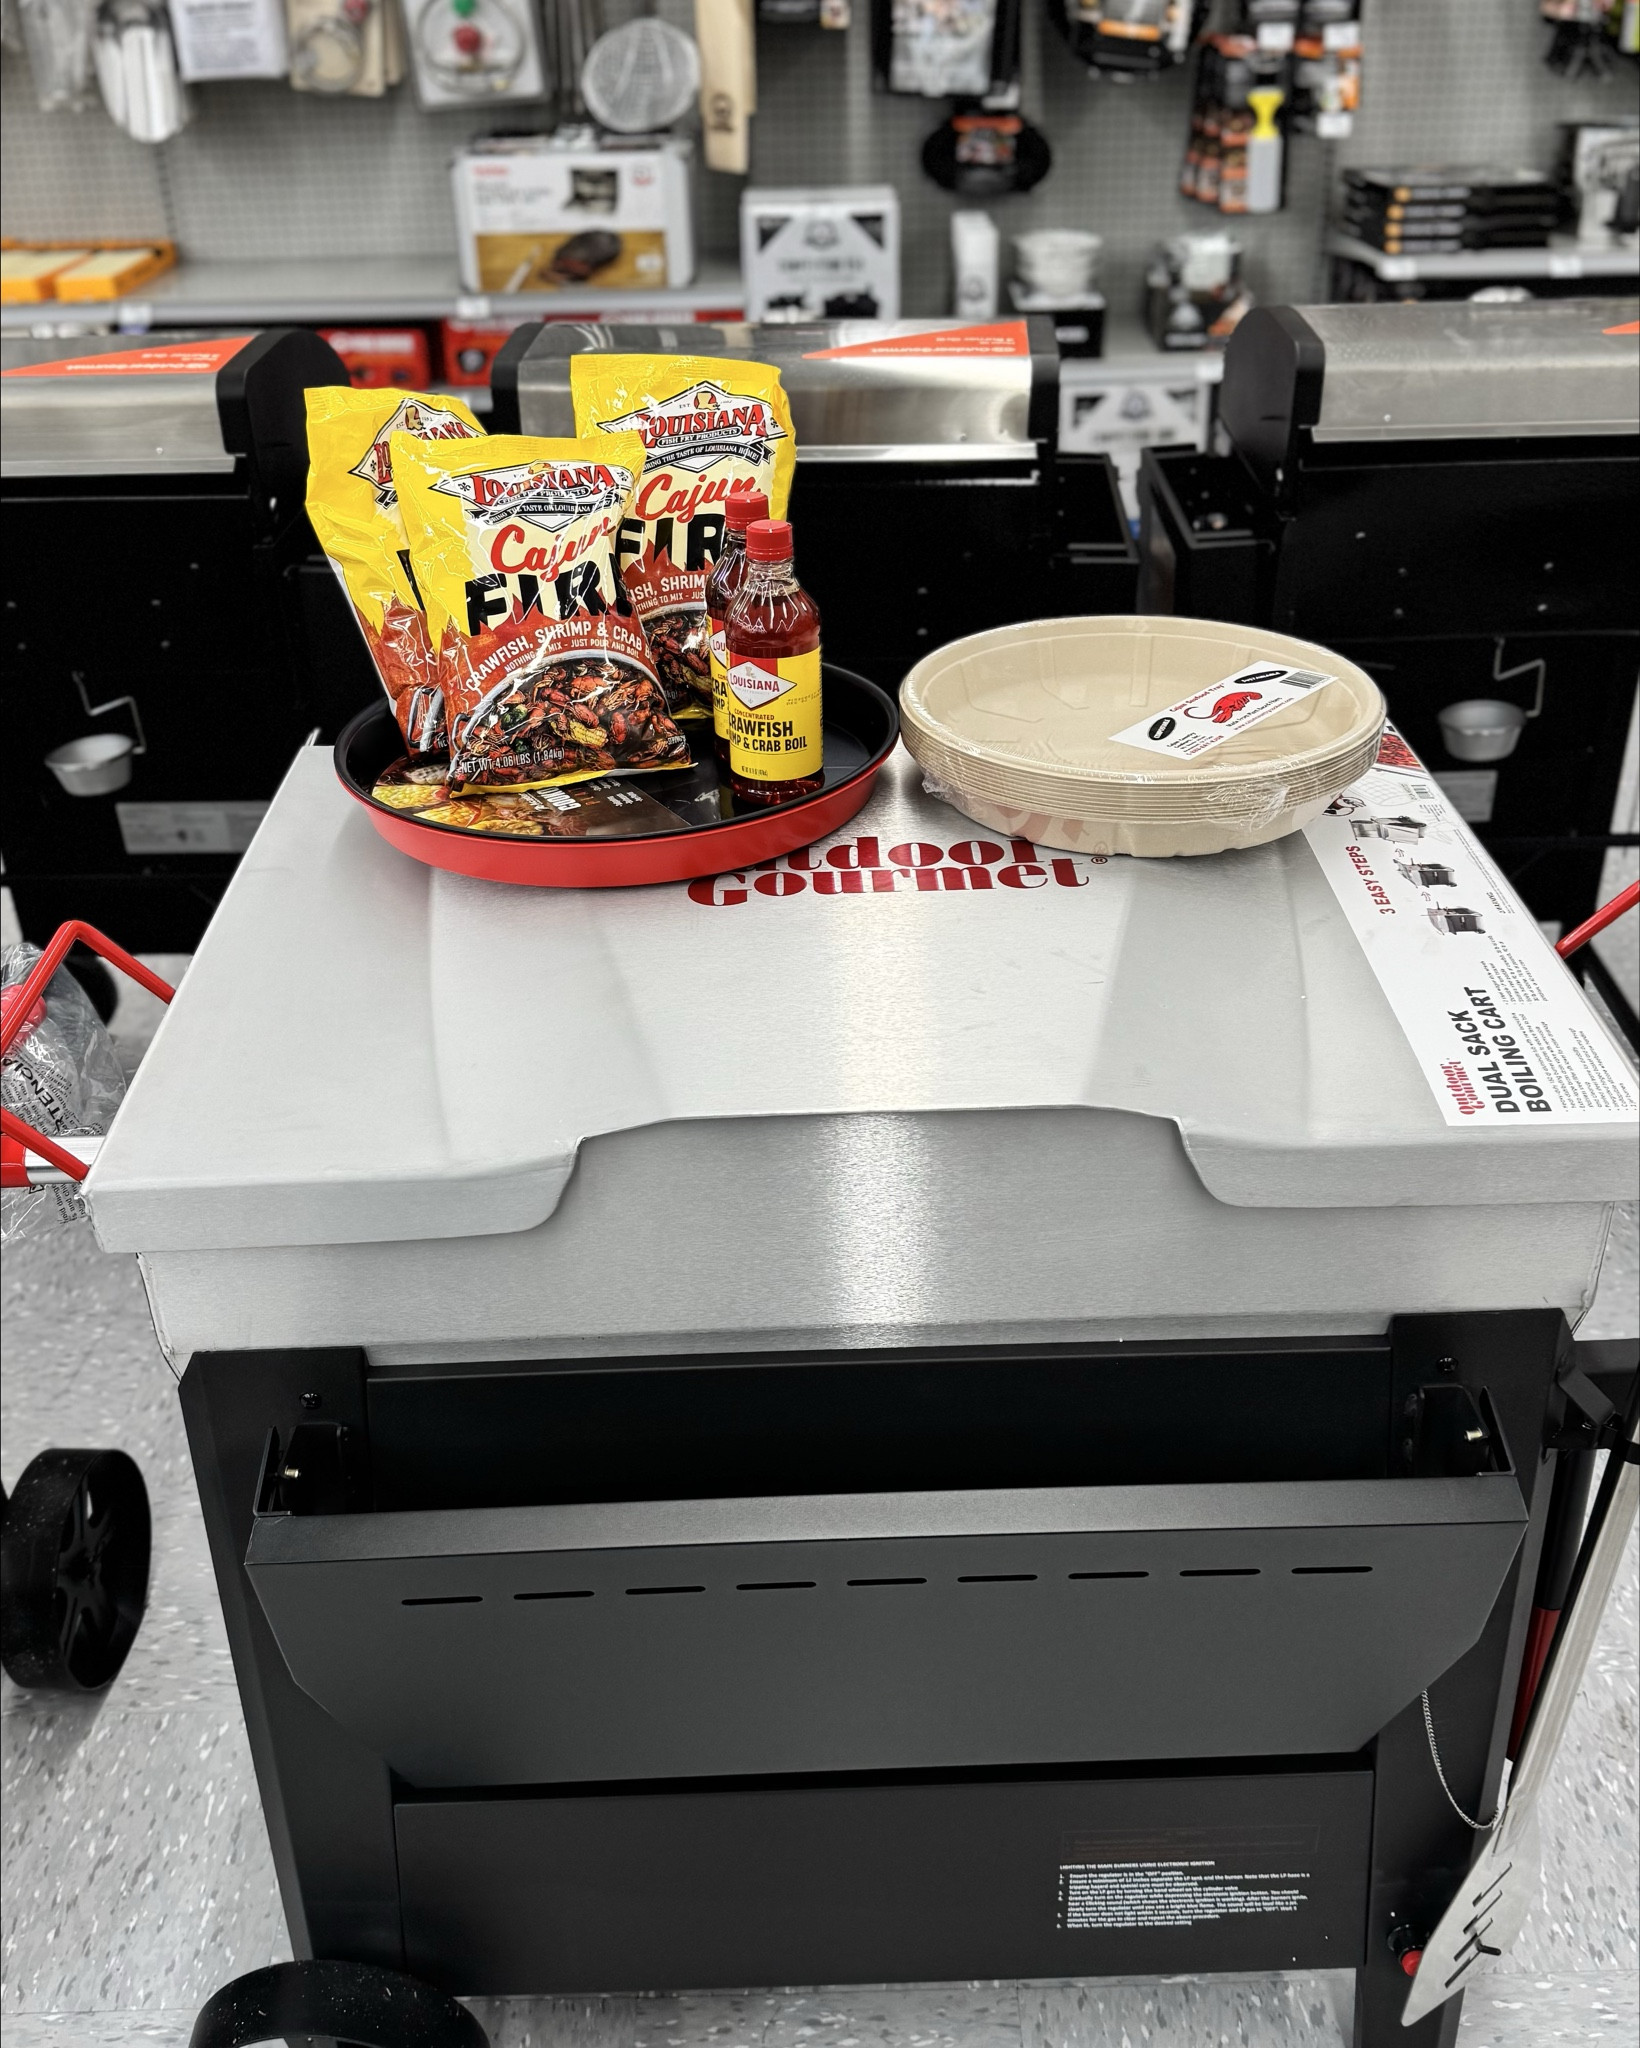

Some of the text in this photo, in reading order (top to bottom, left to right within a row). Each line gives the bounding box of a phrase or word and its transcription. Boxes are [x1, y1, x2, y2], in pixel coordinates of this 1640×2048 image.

[636, 404, 768, 448] LOUISIANA
[661, 428, 738, 445] FISH FRY PRODUCTS
[663, 454, 675, 465] THE
[676, 449, 694, 461] TASTE
[695, 446, 703, 454] OF
[705, 444, 736, 453] LOUISIANA
[470, 465, 616, 506] LOUISIANA
[635, 474, 761, 523] Cajun
[491, 517, 617, 582] Cajun
[615, 513, 726, 572] FIR
[636, 590, 705, 612] THING TO MIX JUS
[660, 574, 709, 592] SHRIM
[466, 621, 642, 691] CRAWFISH, SHRIMP & CRAB
[504, 651, 536, 673] NOTHING
[548, 643, 562, 653] MIX
[571, 639, 588, 648] JUST
[611, 642, 625, 652] AND
[626, 647, 639, 659] BOIL
[729, 673, 780, 693] LOUISIANA
[734, 708, 774, 721] CONCENTRATED
[461, 761, 478, 774] NET
[515, 753, 530, 765] LBS
[533, 749, 565, 764] (1.84kg)
[744, 738, 750, 750] &
[753, 739, 781, 752] CRAB
[785, 736, 807, 751] BOIL
[736, 836, 1045, 873] tdoor
[1345, 846, 1374, 877] STEPS
[687, 858, 1090, 907] Gourmet
[1363, 878, 1391, 906] EASY
[1463, 987, 1506, 1029] CART
[1447, 1010, 1520, 1113] DUAL SACK
[1492, 1034, 1552, 1112] BOILING
[1440, 1063, 1475, 1115] Outdoor
[1449, 1061, 1485, 1109] Gourmet
